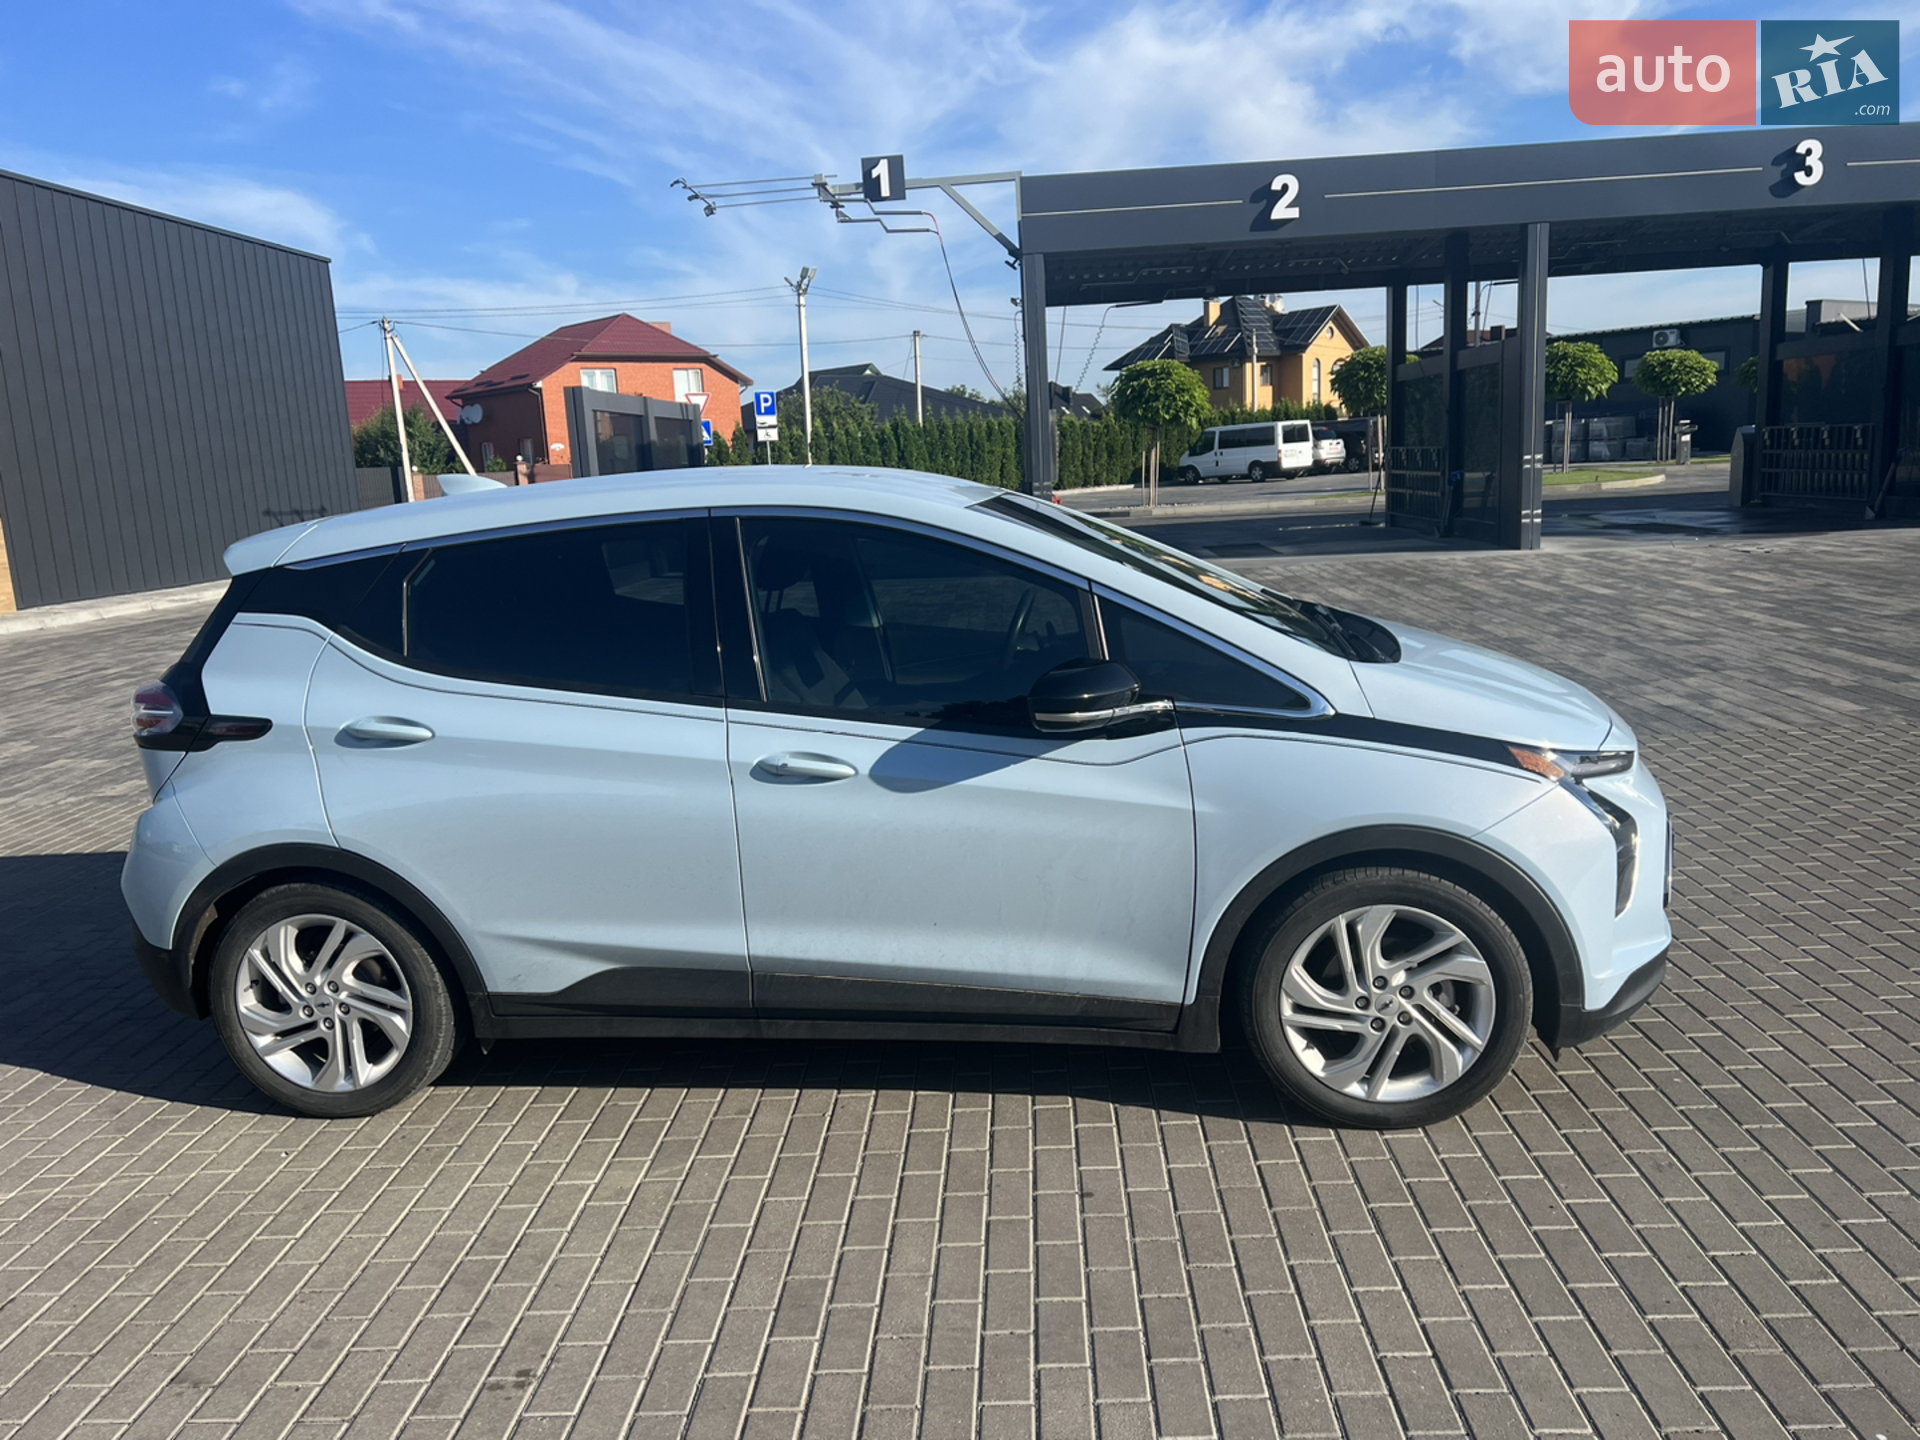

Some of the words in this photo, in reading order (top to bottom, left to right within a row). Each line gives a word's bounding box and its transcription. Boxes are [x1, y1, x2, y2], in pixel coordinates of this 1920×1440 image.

[871, 158, 891, 197] 1
[1793, 139, 1824, 187] 3
[1270, 174, 1300, 220] 2
[760, 394, 772, 414] P
